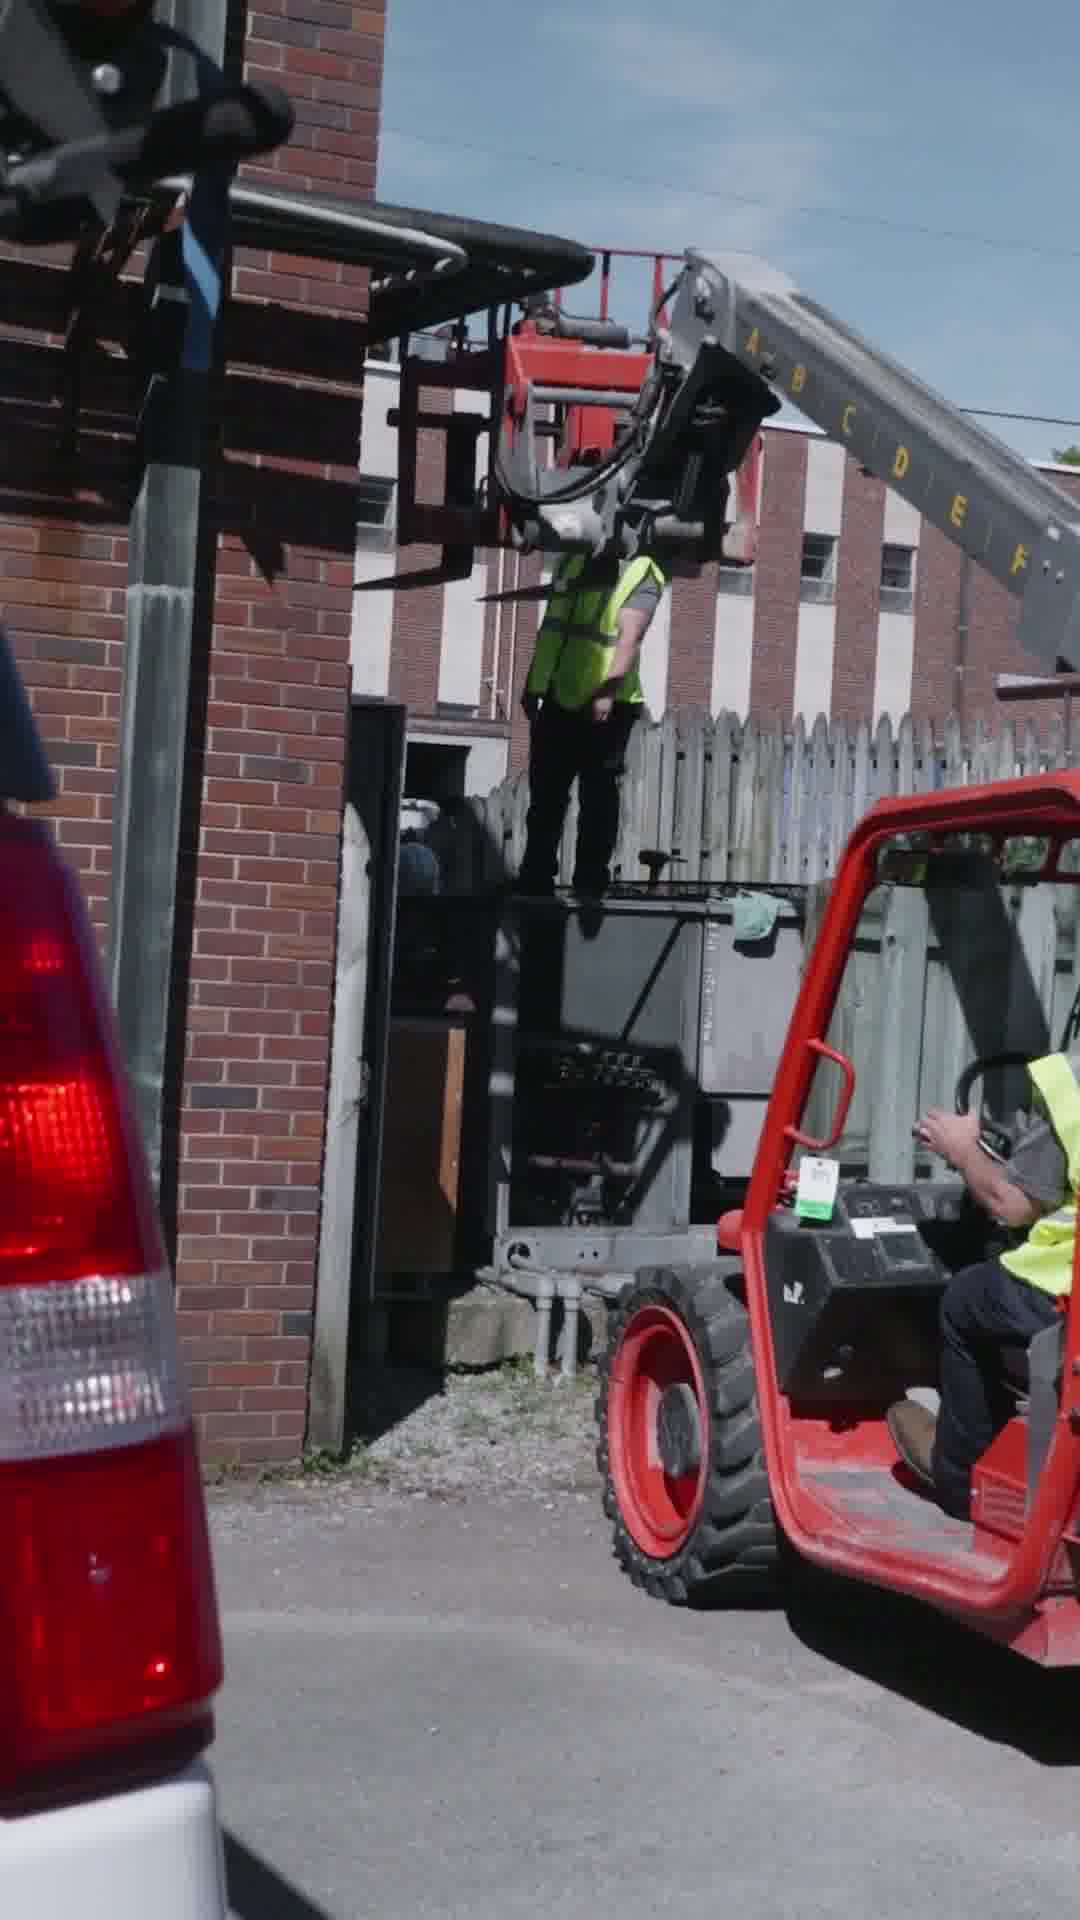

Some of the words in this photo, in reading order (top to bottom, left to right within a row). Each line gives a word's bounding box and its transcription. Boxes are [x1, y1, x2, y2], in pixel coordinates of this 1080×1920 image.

[744, 327, 760, 353] A
[791, 364, 808, 392] B
[892, 446, 909, 479] D
[950, 495, 968, 527] E
[1010, 543, 1029, 574] F
